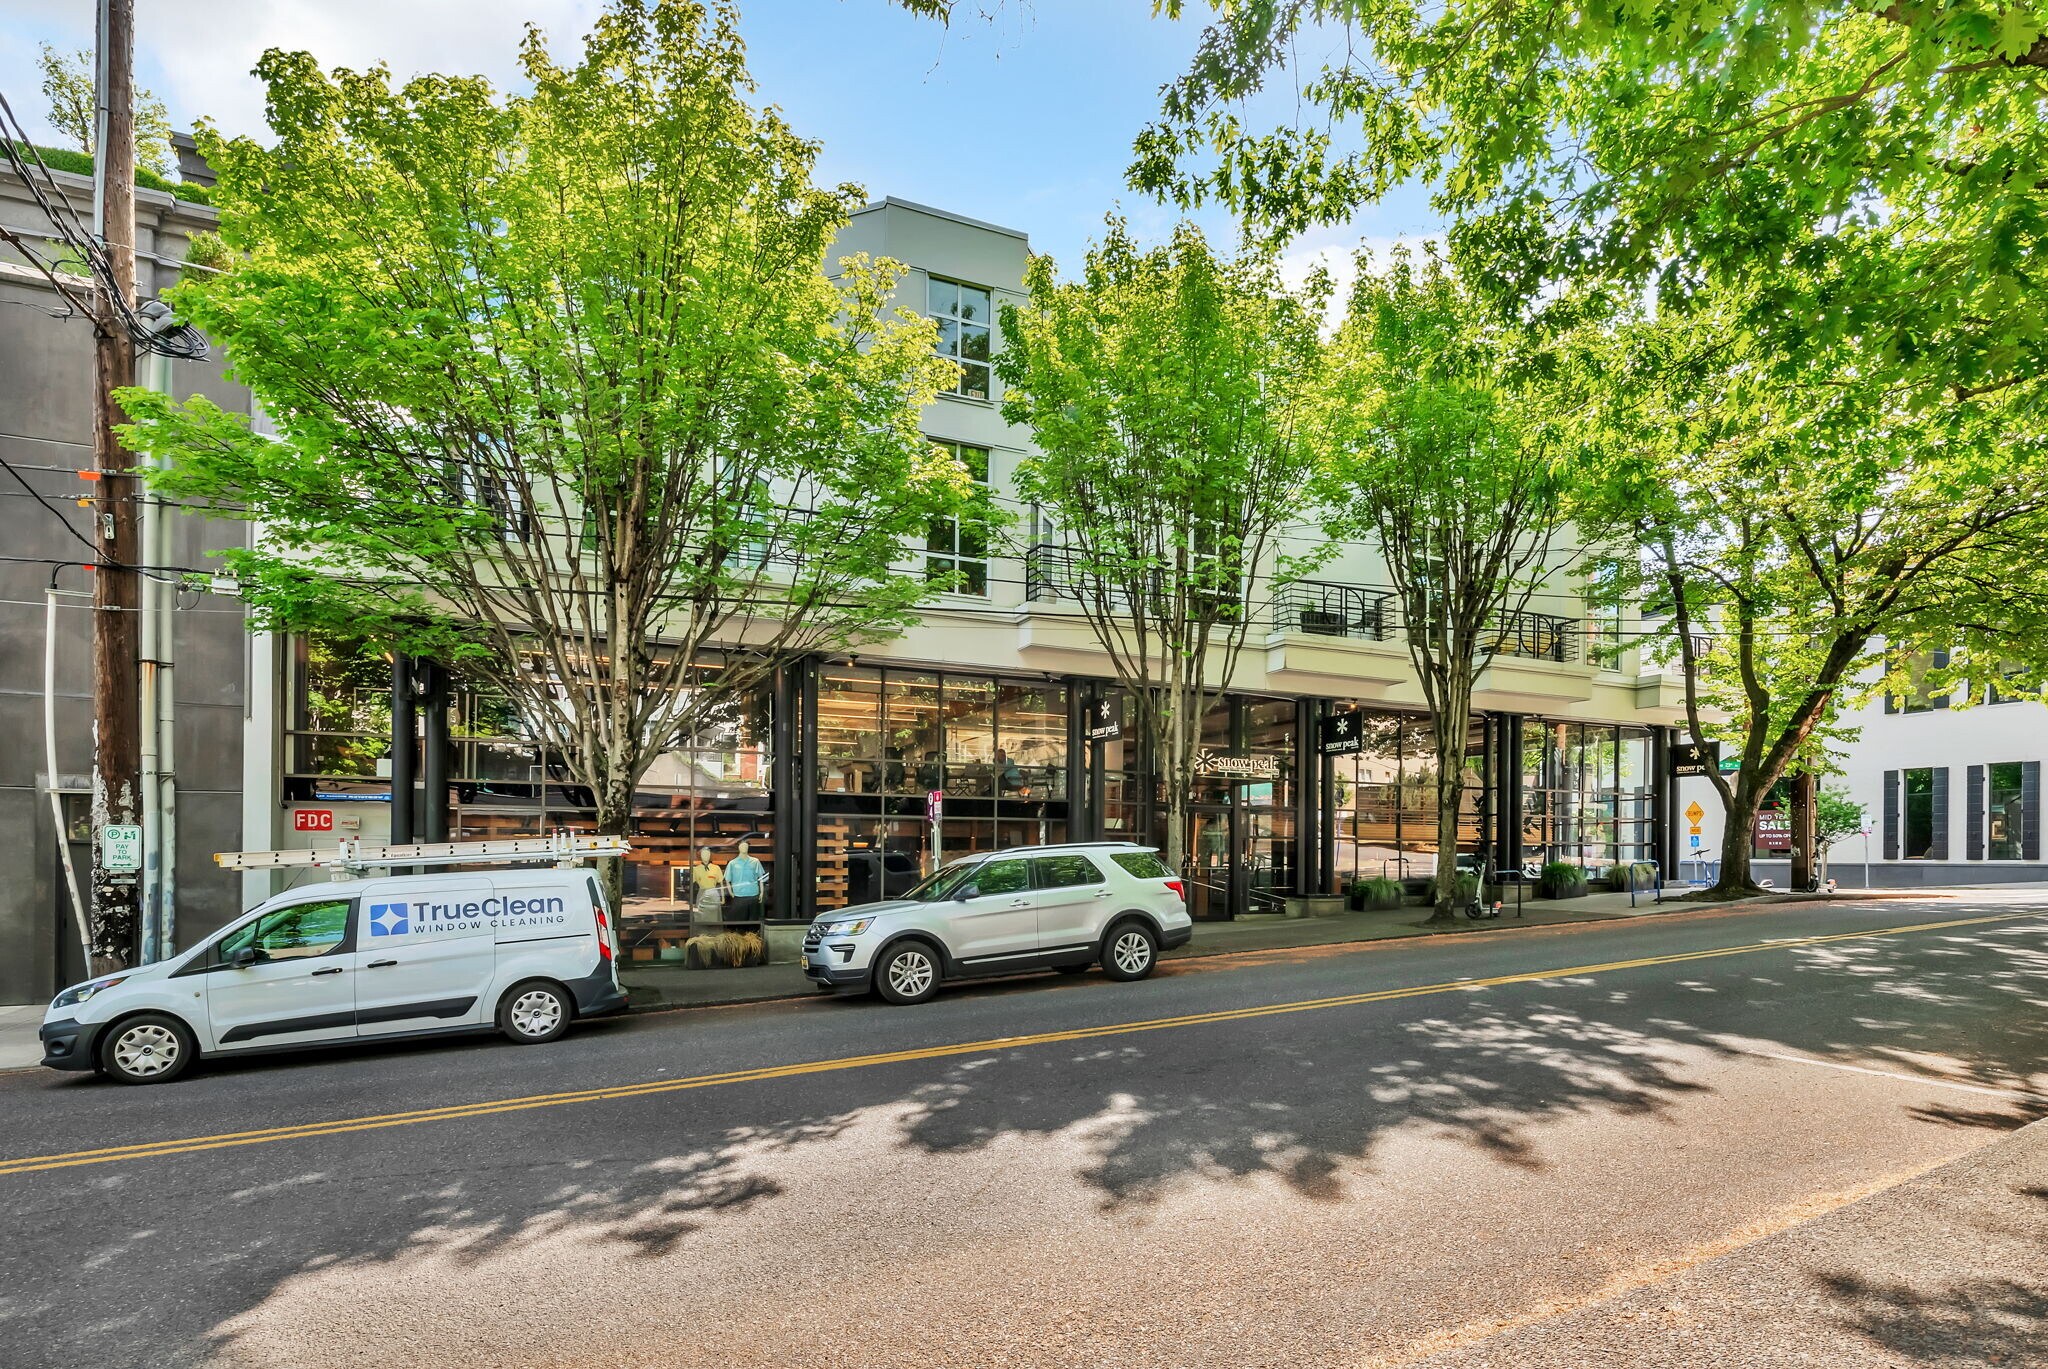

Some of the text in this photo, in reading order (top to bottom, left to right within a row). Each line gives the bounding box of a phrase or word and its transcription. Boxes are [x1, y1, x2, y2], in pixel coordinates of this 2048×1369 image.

[1092, 721, 1119, 737] snow peak
[1326, 736, 1359, 750] snow peak
[1218, 755, 1279, 773] snow peak
[1676, 764, 1696, 772] snow
[296, 813, 331, 827] FDC
[1759, 820, 1791, 831] SALE
[413, 896, 564, 922] TrueClean
[414, 915, 564, 934] WINDOW CLEANING
